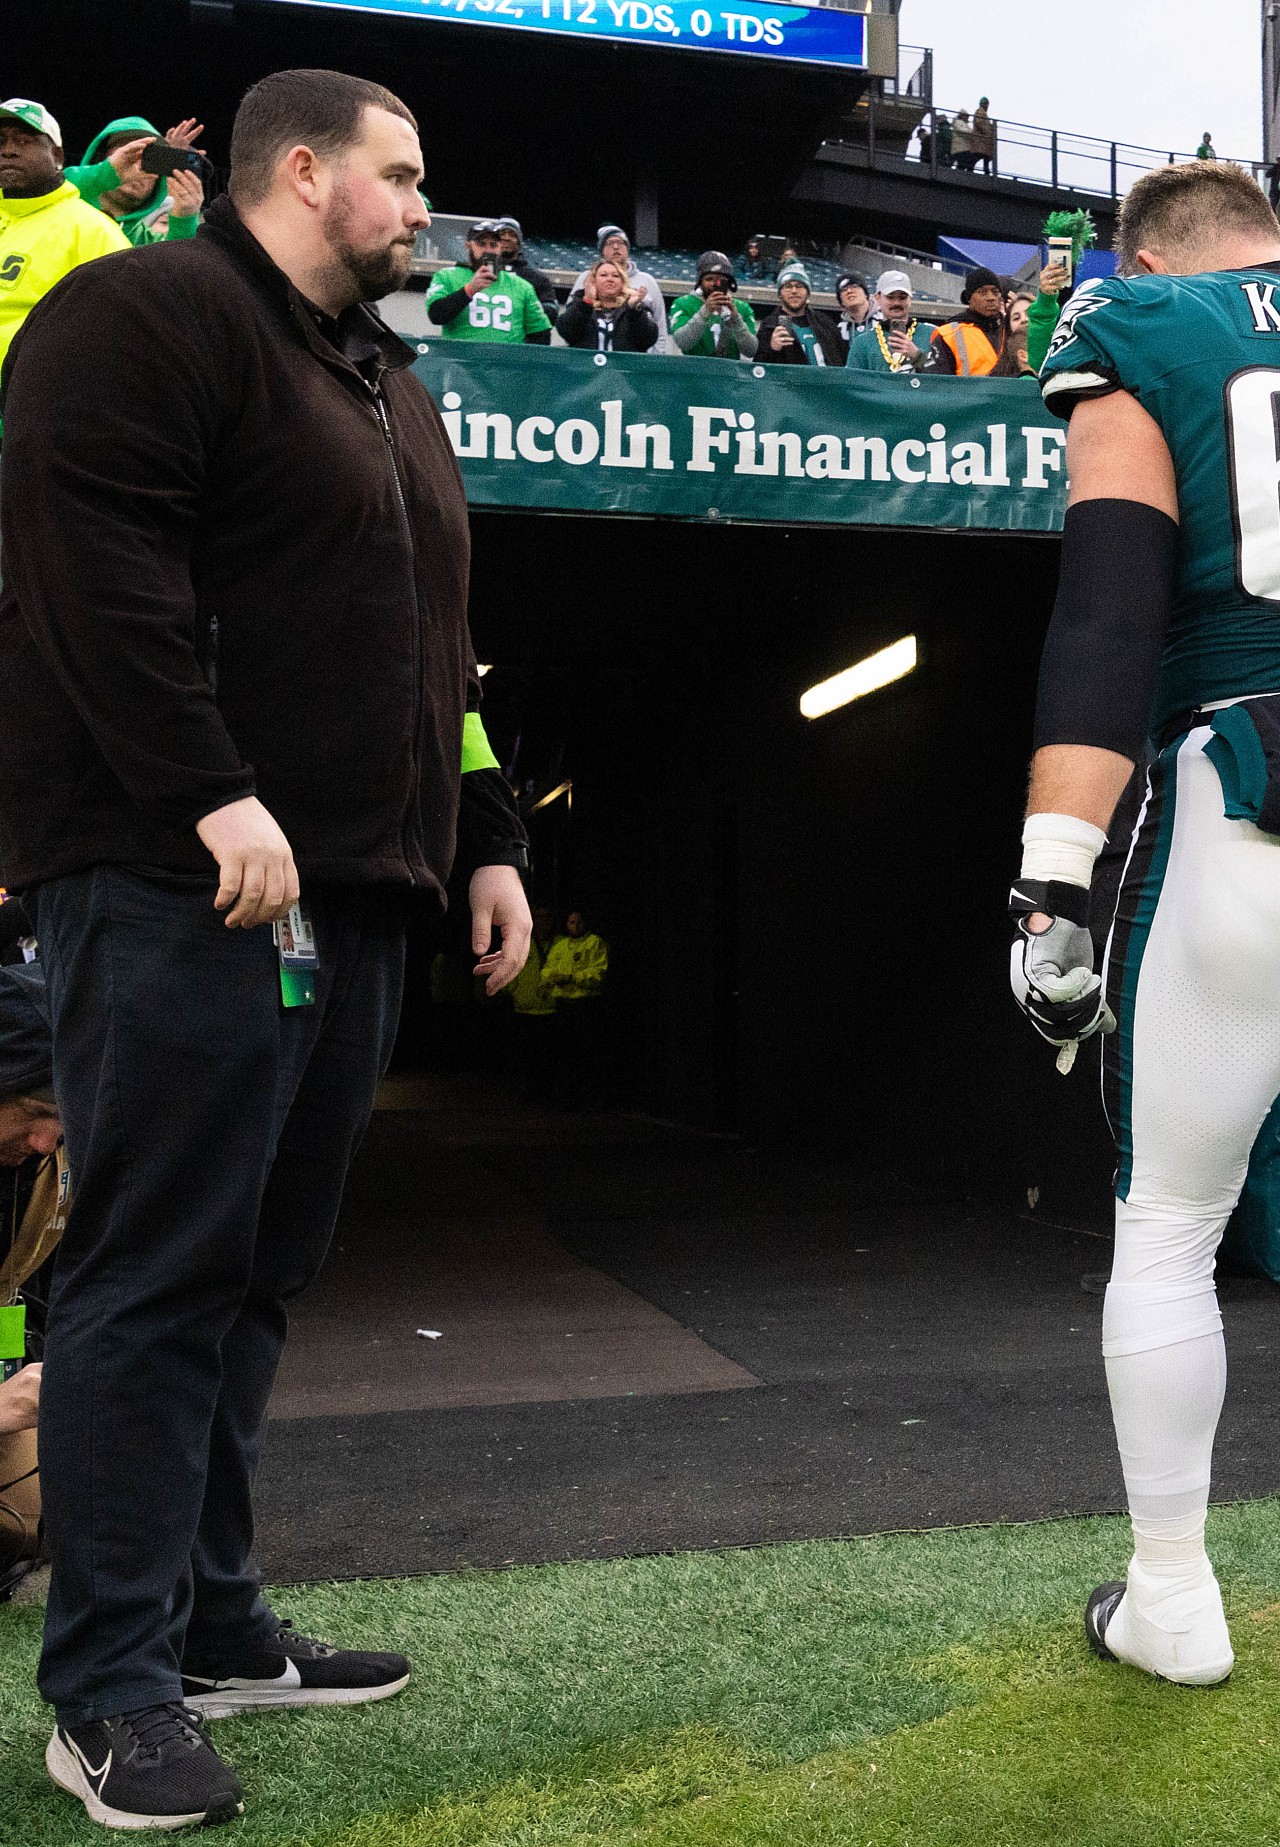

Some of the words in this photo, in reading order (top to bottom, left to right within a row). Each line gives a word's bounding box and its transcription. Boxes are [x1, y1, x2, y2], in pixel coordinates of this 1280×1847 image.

[542, 0, 597, 24] 112
[605, 0, 680, 37] YDS,
[690, 9, 712, 37] 0
[720, 12, 784, 46] TDS
[468, 292, 513, 331] 62
[687, 405, 1010, 487] Financial
[1022, 426, 1068, 488] F
